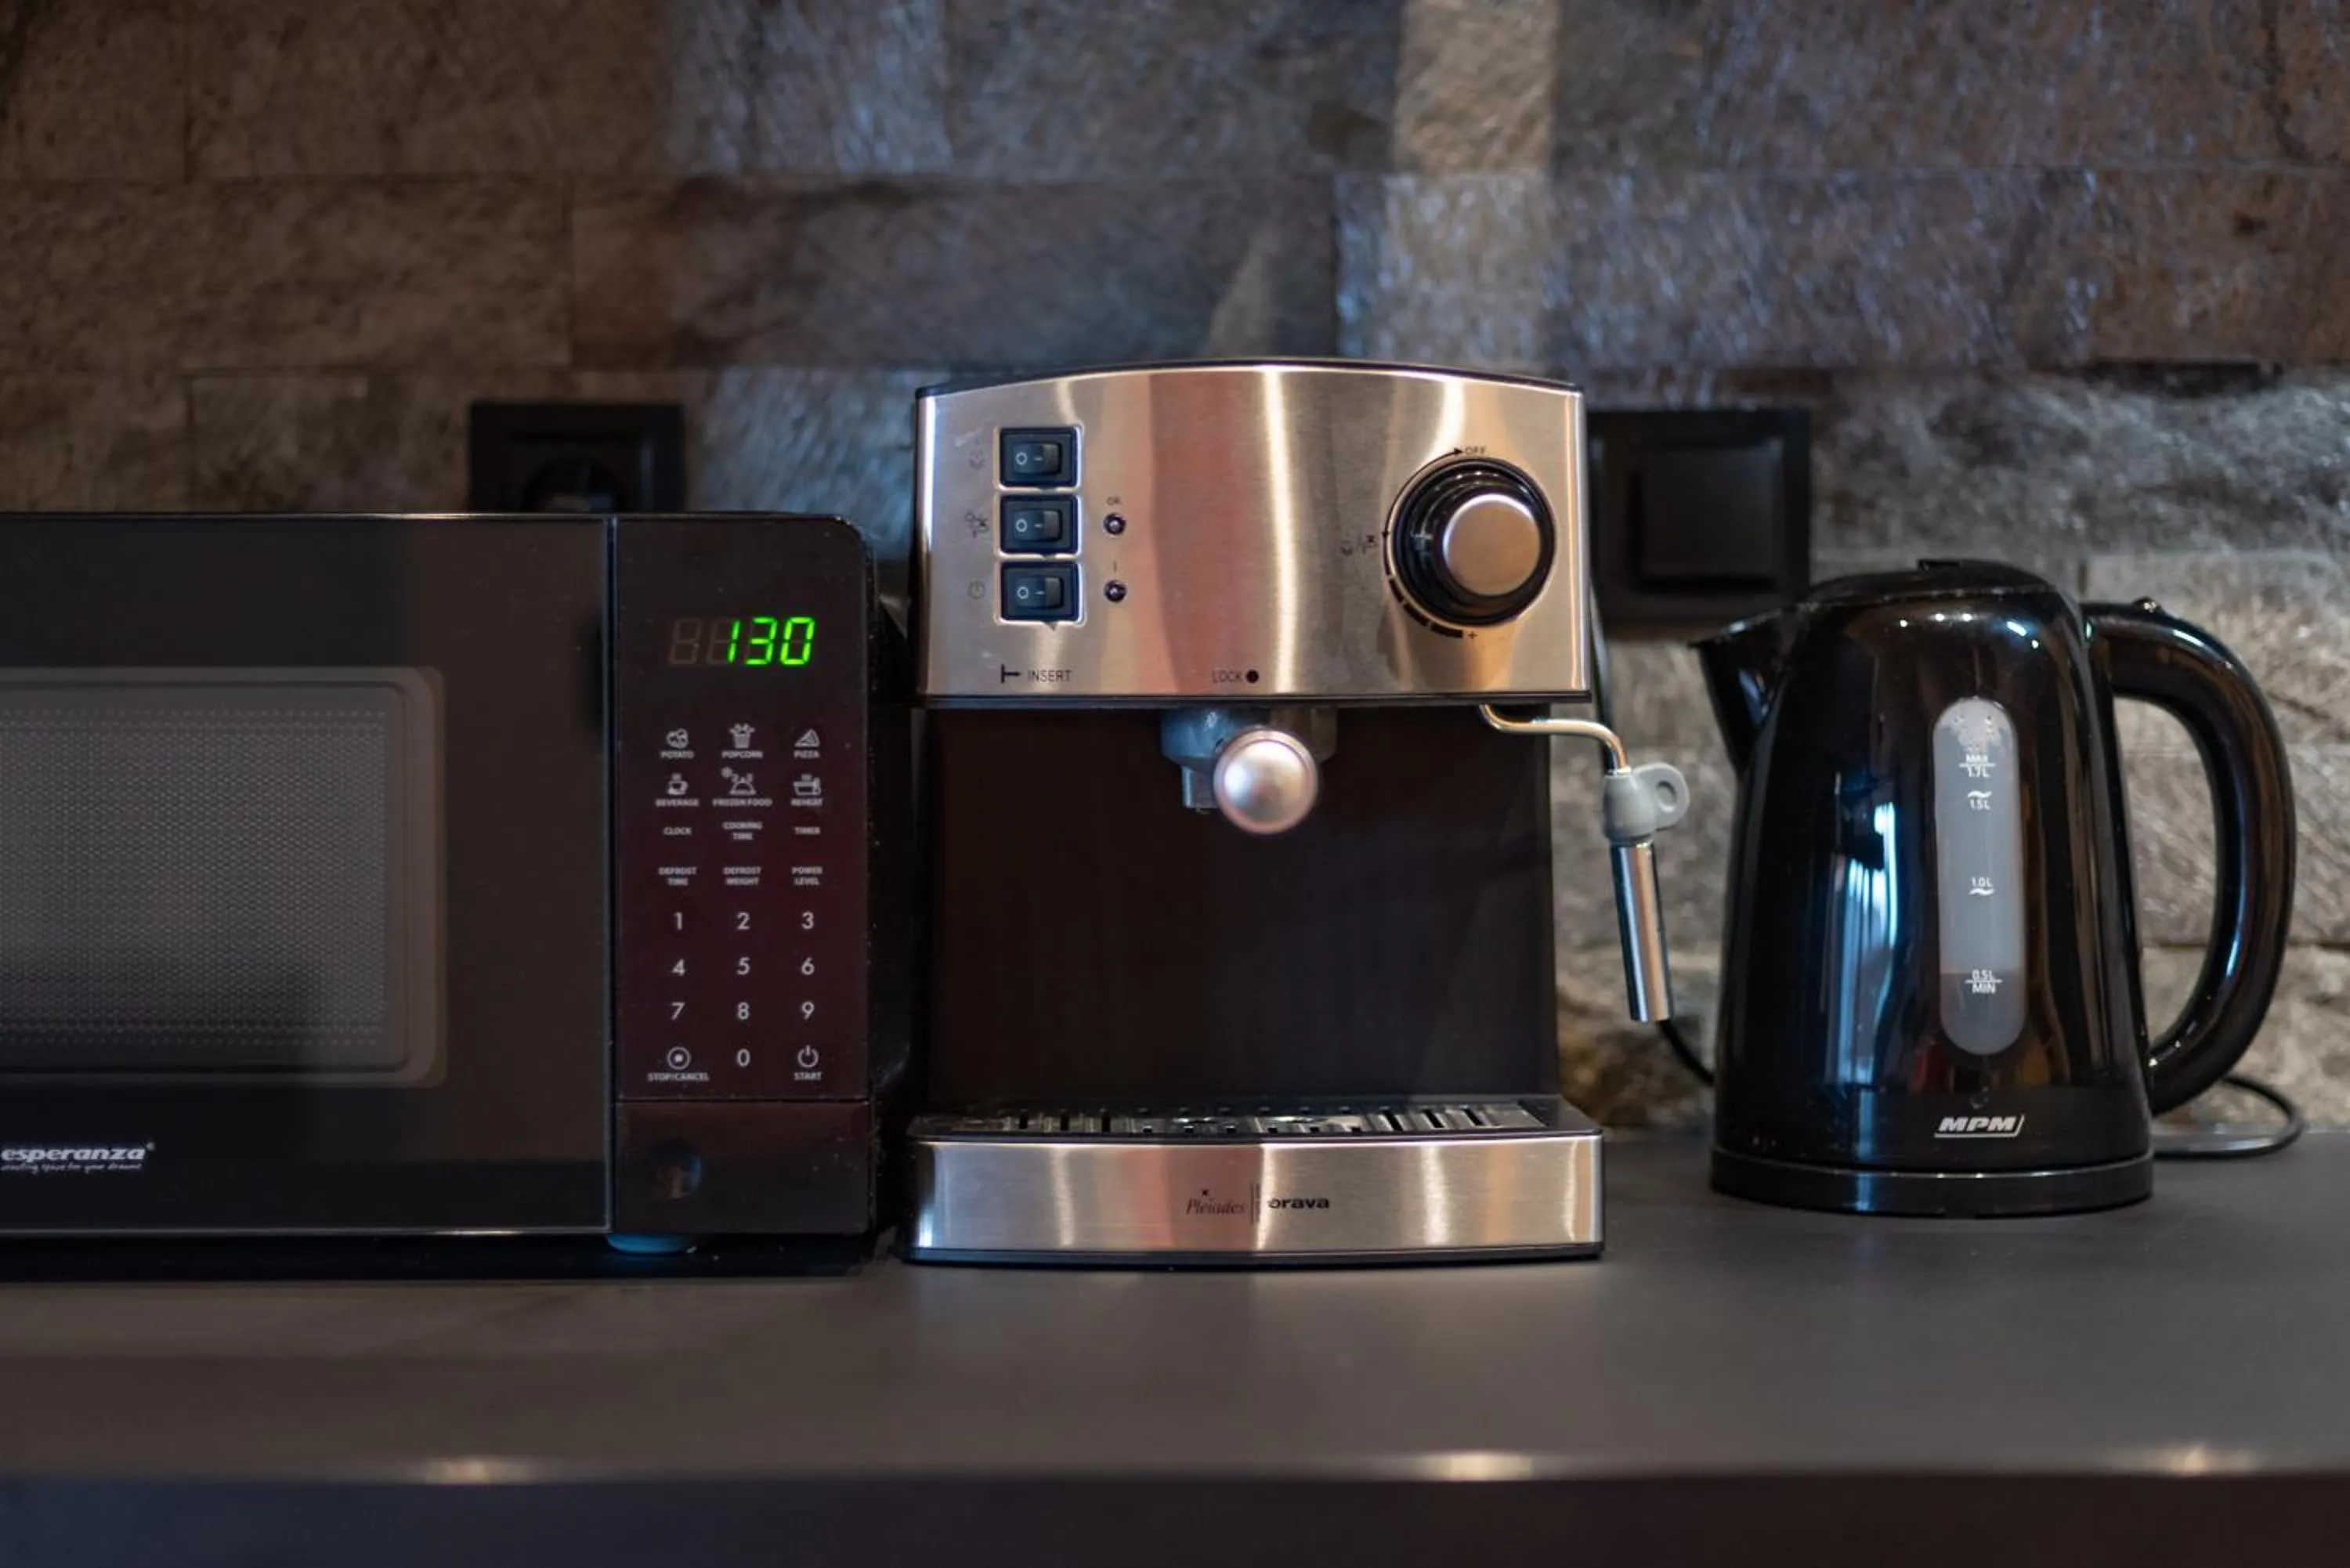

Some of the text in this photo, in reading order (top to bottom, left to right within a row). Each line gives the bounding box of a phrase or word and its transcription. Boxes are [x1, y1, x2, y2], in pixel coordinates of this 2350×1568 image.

[727, 616, 815, 666] 130
[1028, 670, 1072, 682] INSERT
[1212, 670, 1243, 683] LOCK
[660, 750, 695, 760] POTATO
[721, 750, 764, 759] POPCORN
[793, 750, 821, 759] PIZZA
[1965, 753, 1988, 763] MAX
[655, 798, 700, 807] BEVERAGE
[712, 797, 773, 807] FROZEN FOOD
[790, 797, 823, 807] REHEAT
[663, 826, 692, 836] CLOCK
[721, 821, 763, 830] COOKING
[794, 826, 821, 835] TIMER
[732, 832, 754, 840] TIME
[658, 865, 698, 876] DEFROST
[722, 865, 762, 876] DEFROST
[791, 865, 823, 875] POWER
[667, 877, 689, 887] TIME
[725, 876, 760, 886] WEIGHT
[794, 876, 820, 886] LEVEL
[674, 912, 683, 930] 1
[736, 911, 750, 930] 2
[801, 910, 815, 930] 3
[671, 959, 686, 977] 4
[736, 956, 750, 976] 5
[801, 956, 815, 976] 6
[1972, 983, 1996, 994] MIN
[671, 1001, 685, 1021] 7
[736, 1002, 750, 1021] 8
[801, 1000, 815, 1020] 9
[736, 1048, 751, 1068] 0
[647, 1071, 710, 1082] STOP/CANCEL
[794, 1071, 822, 1081] START
[1938, 1116, 2017, 1132] MPM
[1, 1148, 146, 1164] esperanza
[1186, 1198, 1246, 1215] Pleiades
[1268, 1198, 1329, 1209] orava
